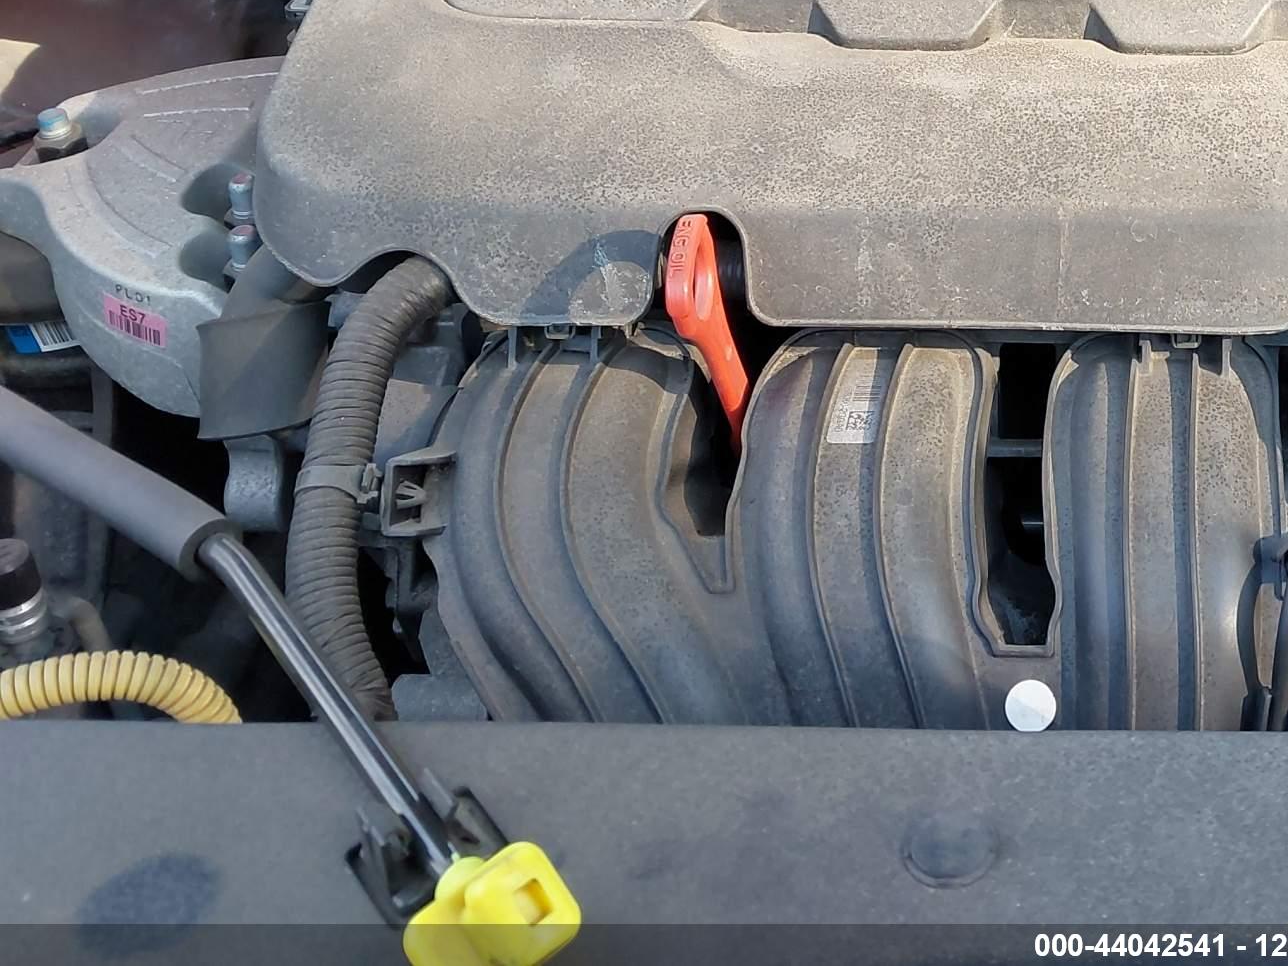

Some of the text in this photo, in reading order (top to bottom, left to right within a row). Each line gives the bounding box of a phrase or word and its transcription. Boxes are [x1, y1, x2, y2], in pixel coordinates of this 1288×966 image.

[669, 219, 693, 278] ENG OIL
[120, 304, 146, 324] ES7
